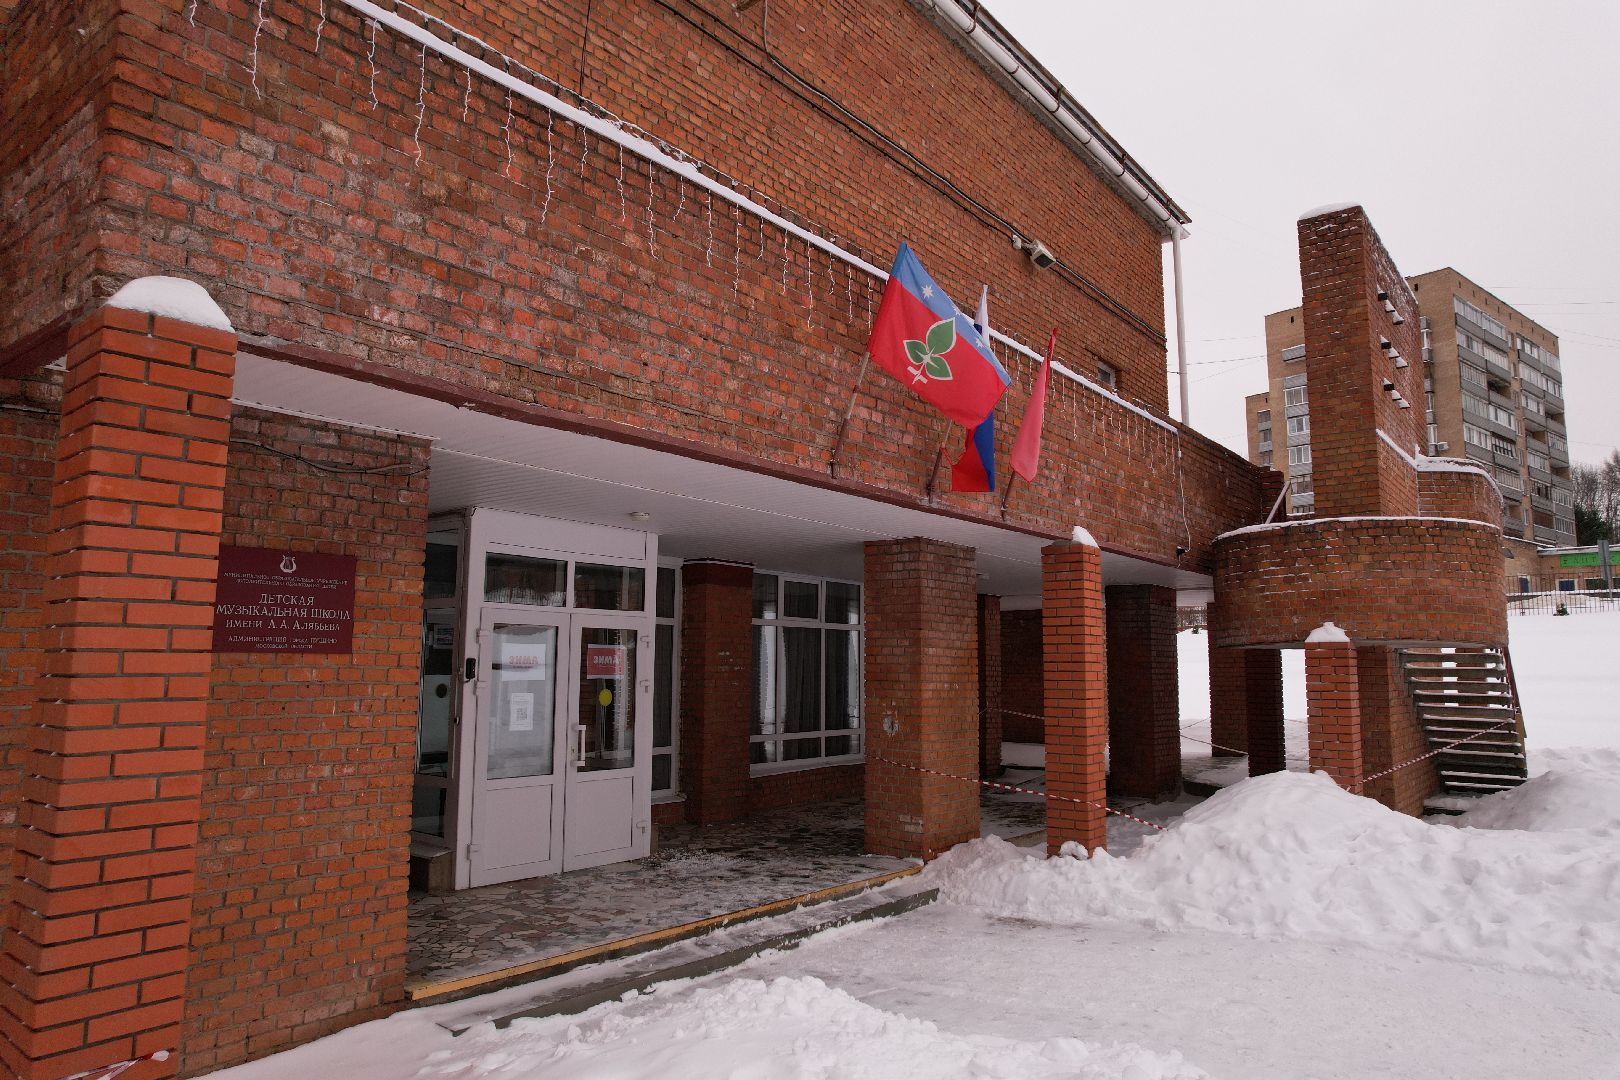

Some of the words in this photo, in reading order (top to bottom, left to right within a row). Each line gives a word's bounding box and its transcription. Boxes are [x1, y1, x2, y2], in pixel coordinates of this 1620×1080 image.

[258, 593, 315, 606] ДЕТСКАЯ
[216, 604, 307, 618] МУЗЫКАЛЬНАЯ
[310, 608, 351, 620] ШКОЛА
[225, 619, 262, 628] ИМЕНИ
